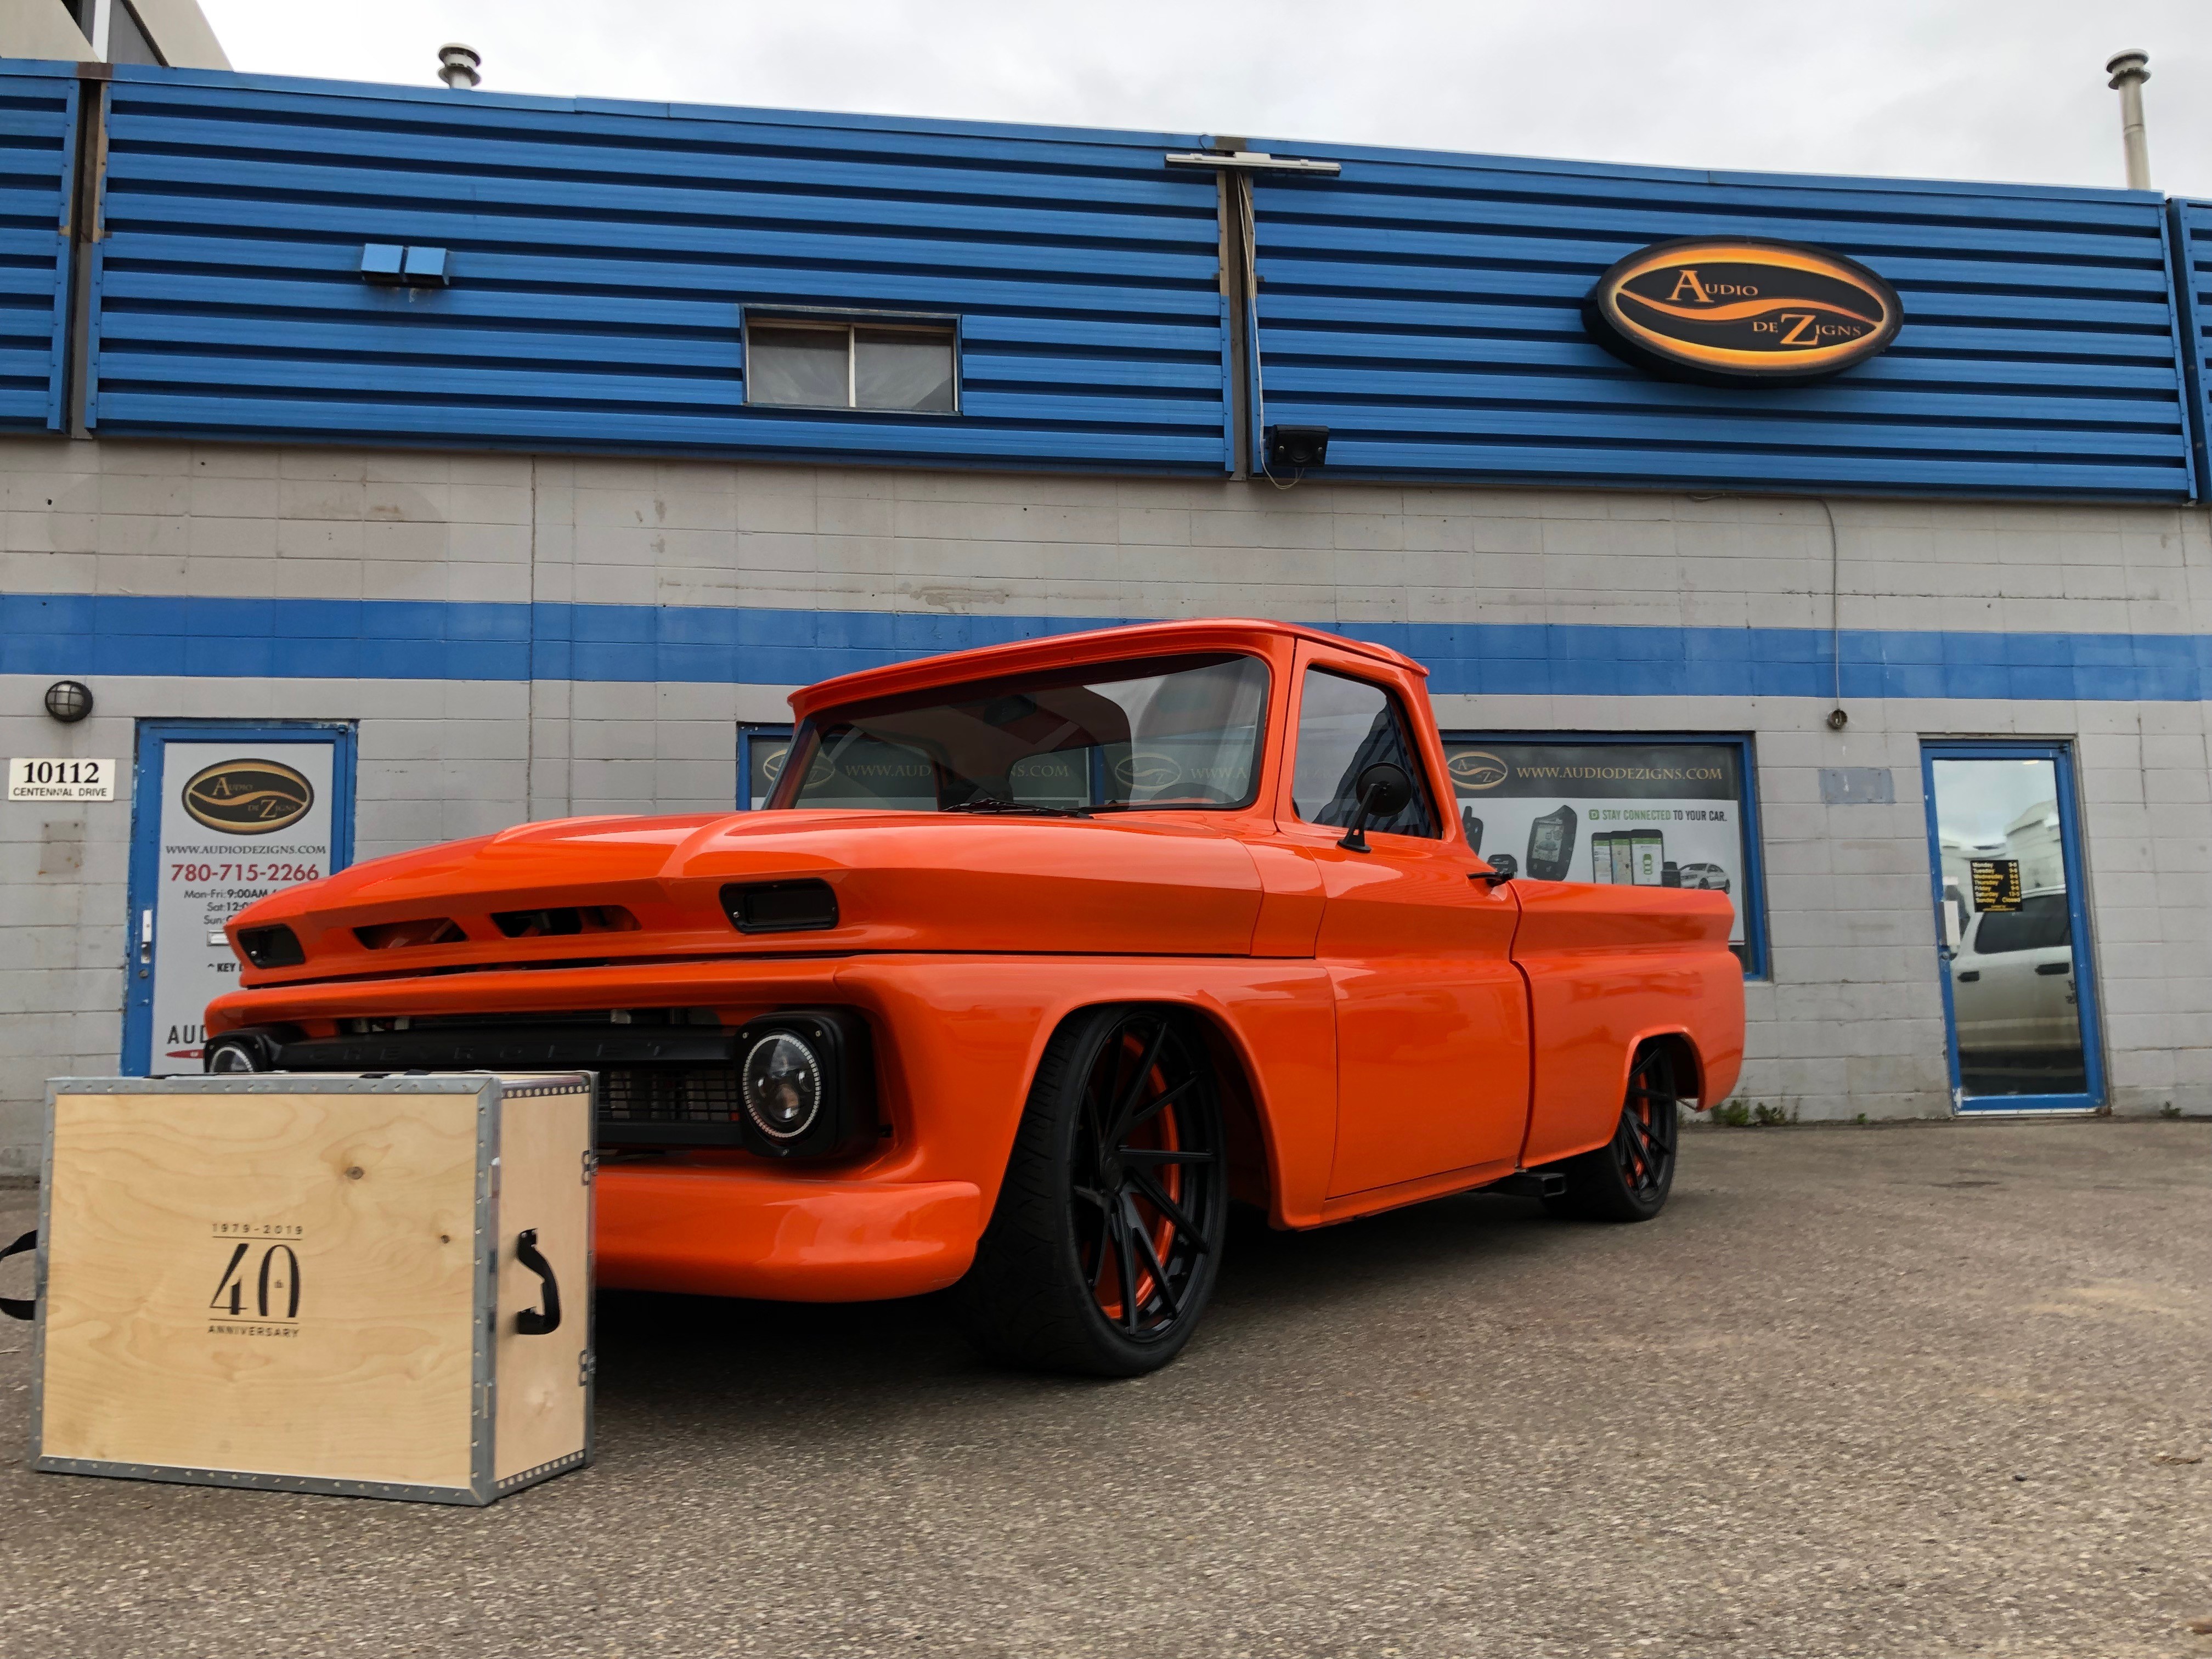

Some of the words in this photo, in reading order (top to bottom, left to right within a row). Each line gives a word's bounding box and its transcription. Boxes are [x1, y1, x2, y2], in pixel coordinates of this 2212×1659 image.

[1666, 269, 1759, 303] AUDIO
[23, 761, 99, 783] 10112
[1516, 767, 1723, 781] WWW.AUDIODEZIGNS.COM
[13, 787, 73, 797] CENTENNIAL
[78, 787, 108, 797] DRIVE
[1602, 810, 1621, 820] STAY
[1623, 810, 1671, 821] CONNECTED
[1673, 810, 1683, 821] TO
[1685, 810, 1706, 821] YOUR
[1709, 810, 1728, 822] CAR.
[165, 845, 326, 854] WWW.AUDIODEZIGNS.COM
[171, 863, 320, 882] 780-715-2266
[217, 963, 235, 973] KEY
[211, 1223, 303, 1235] 1979-2019
[209, 1243, 301, 1318] 40
[207, 1325, 300, 1338] ANNIVERSARY
